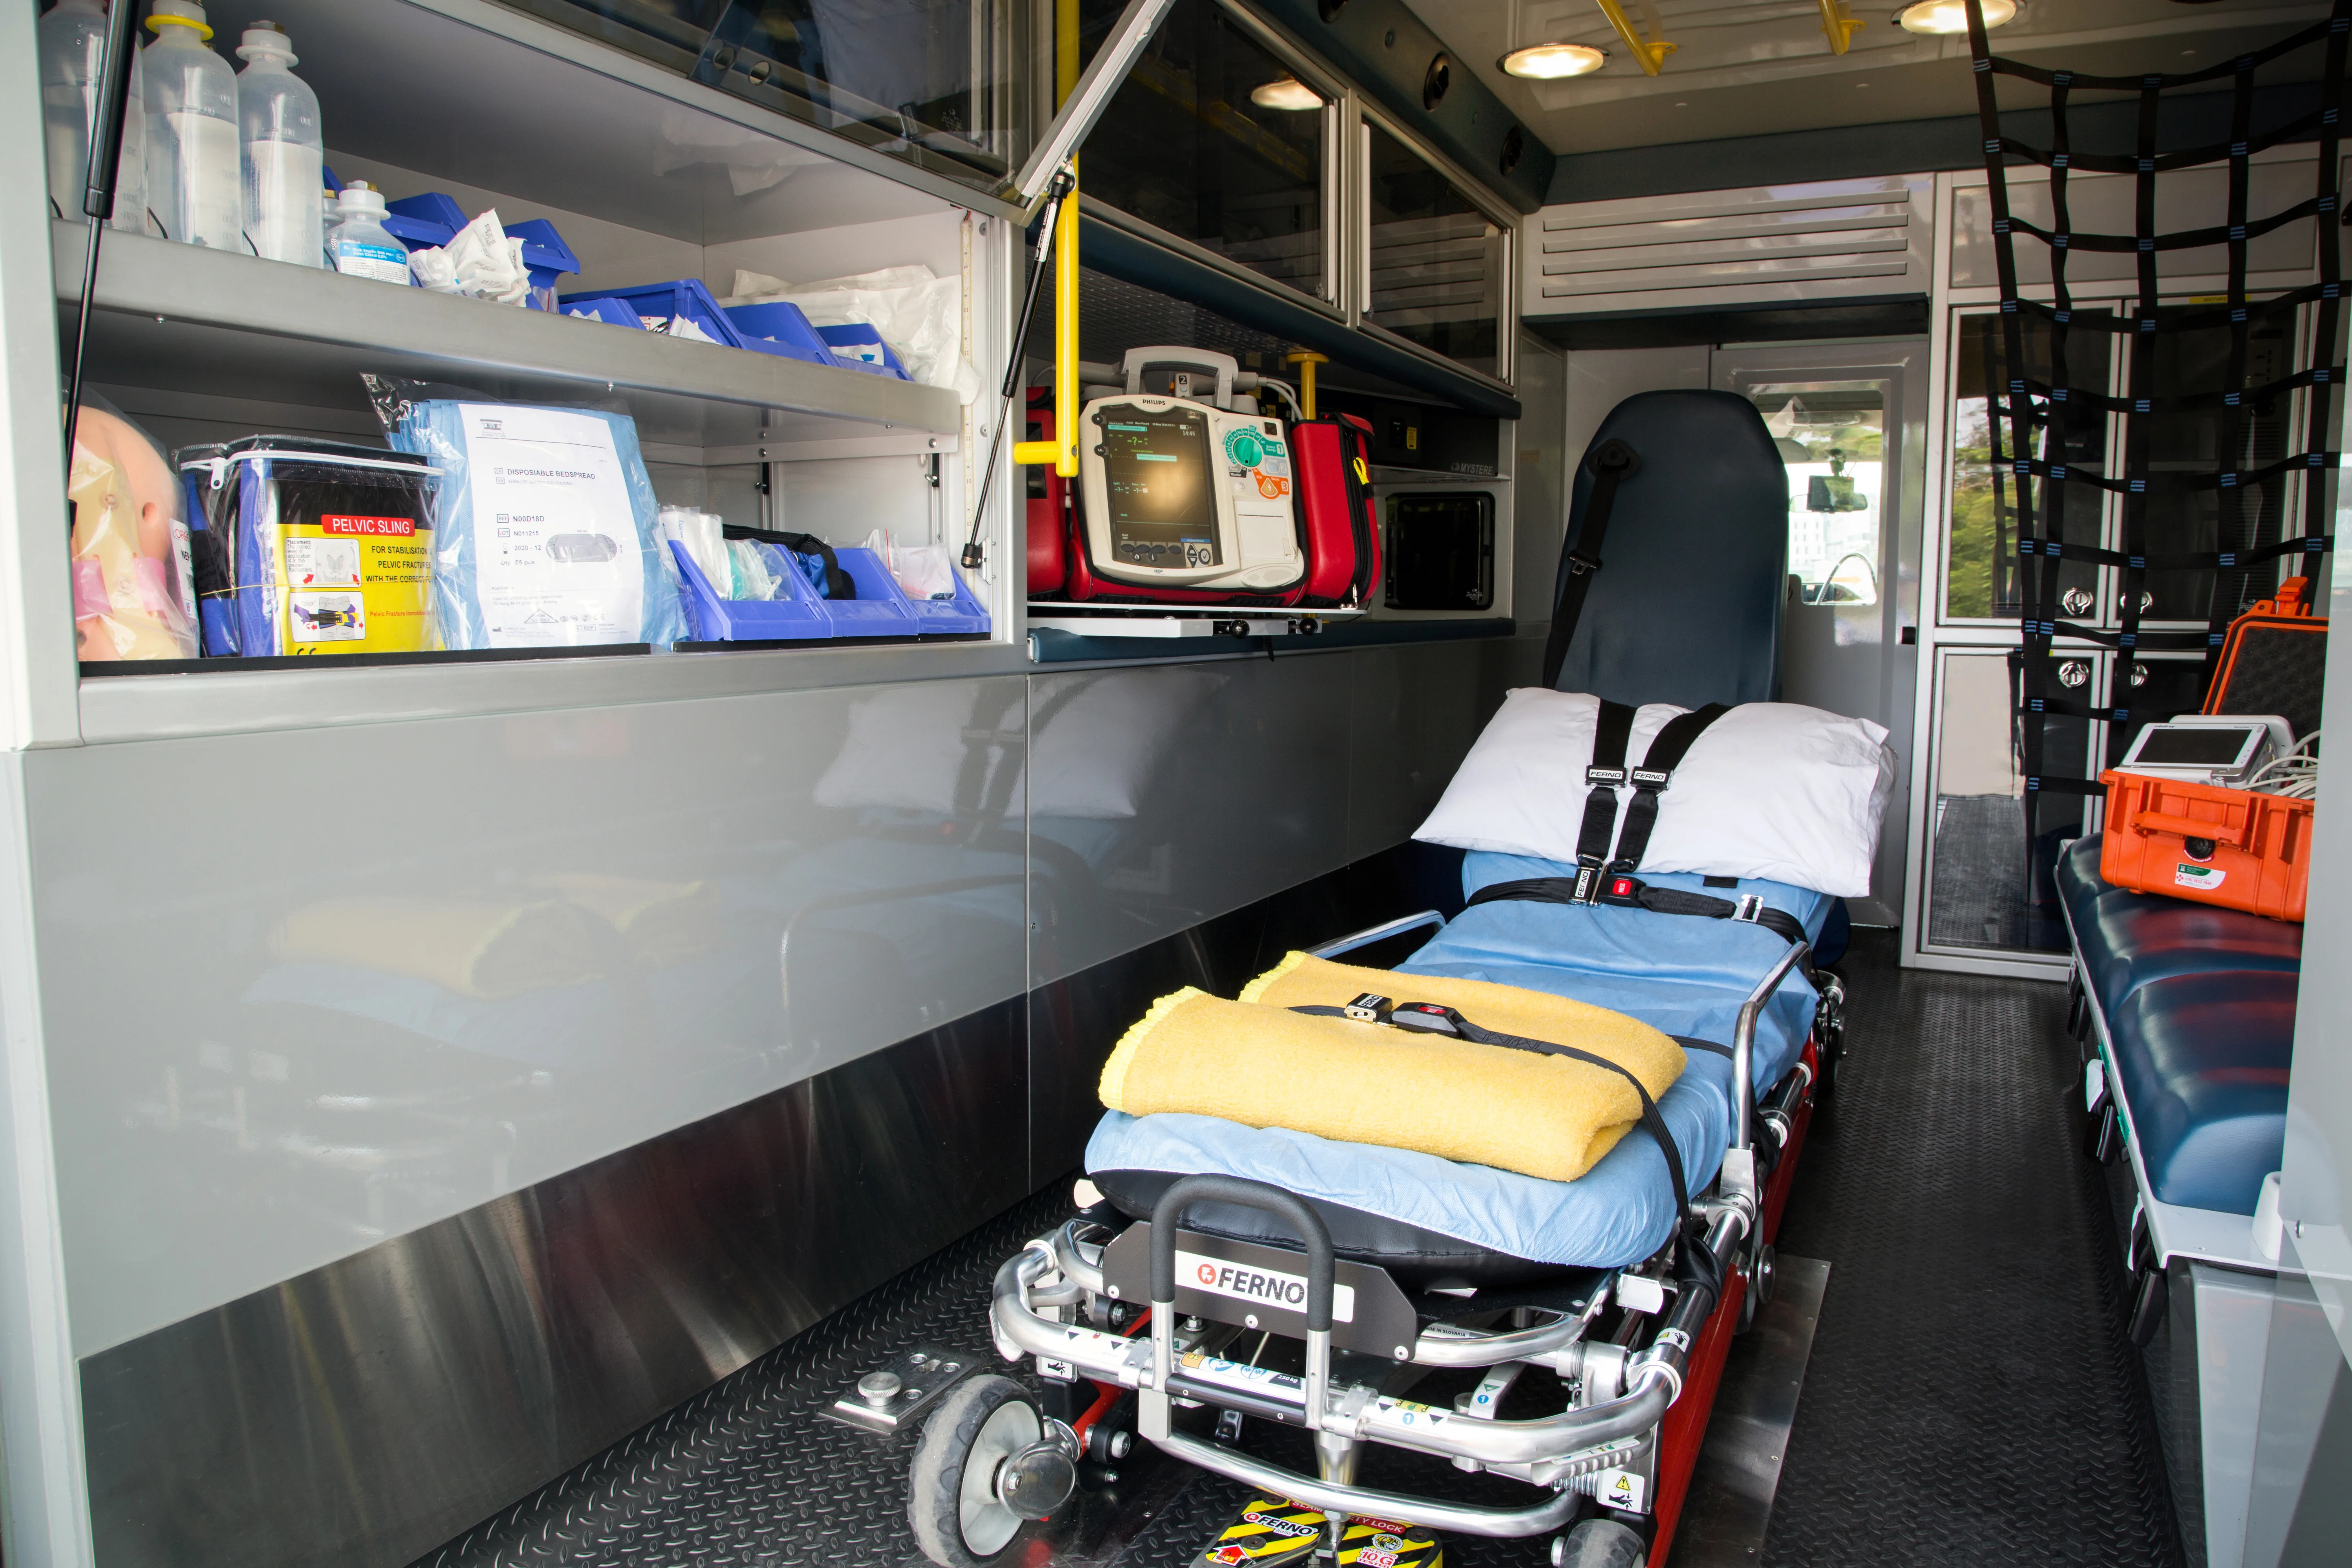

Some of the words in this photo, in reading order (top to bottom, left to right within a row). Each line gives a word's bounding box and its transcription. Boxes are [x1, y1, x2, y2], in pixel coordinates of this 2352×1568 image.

[1460, 463, 1493, 475] MYSTERE
[1282, 482, 1287, 490] 3
[332, 518, 375, 533] PELVIC
[378, 520, 410, 534] SLING
[388, 546, 427, 555] STABILISATION
[403, 561, 431, 569] FRACTURES
[1578, 872, 1588, 896] FERNO
[1362, 996, 1381, 1007] FERNO
[1218, 1267, 1305, 1304] FERNO
[1406, 1414, 1411, 1424] 1
[1292, 1500, 1323, 1513] SLAM
[1371, 1520, 1403, 1533] LOCK
[1258, 1516, 1314, 1535] FERNO
[1358, 1558, 1390, 1568] TESTED
